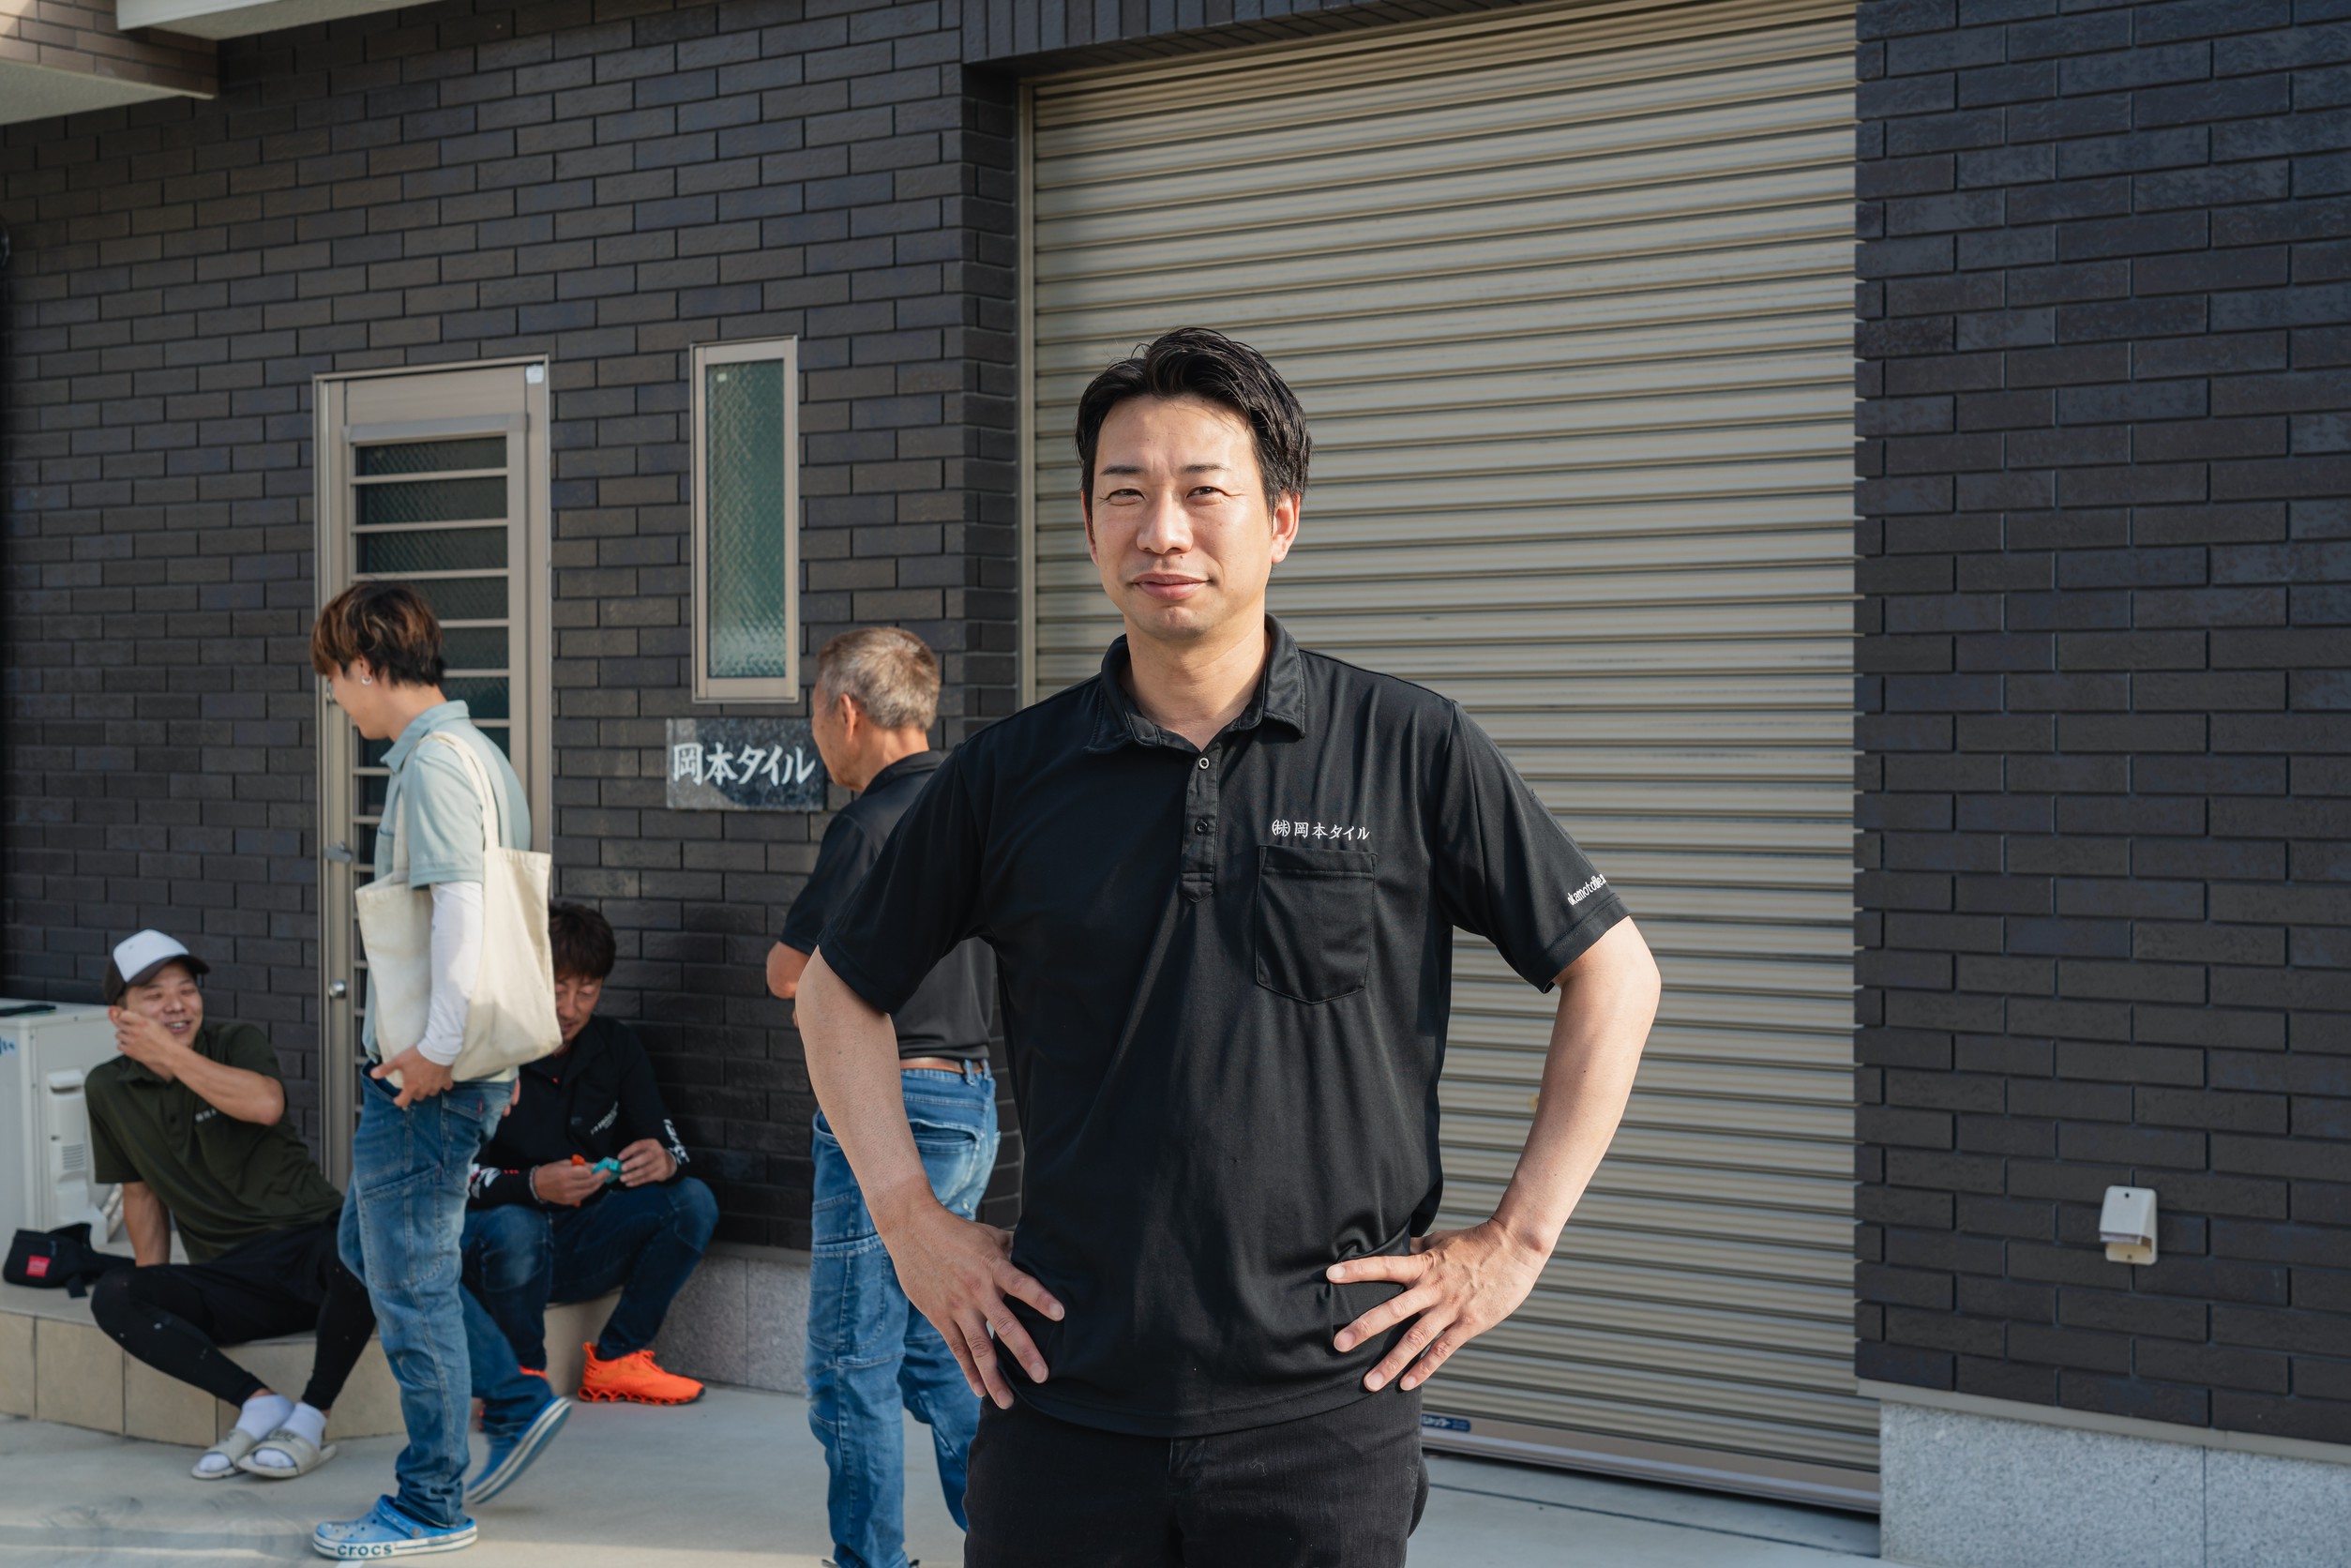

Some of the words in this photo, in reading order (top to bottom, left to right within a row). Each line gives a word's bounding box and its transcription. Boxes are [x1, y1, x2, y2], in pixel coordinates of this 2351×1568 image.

[673, 742, 816, 787] 岡本タイル
[337, 1543, 393, 1557] crocs
